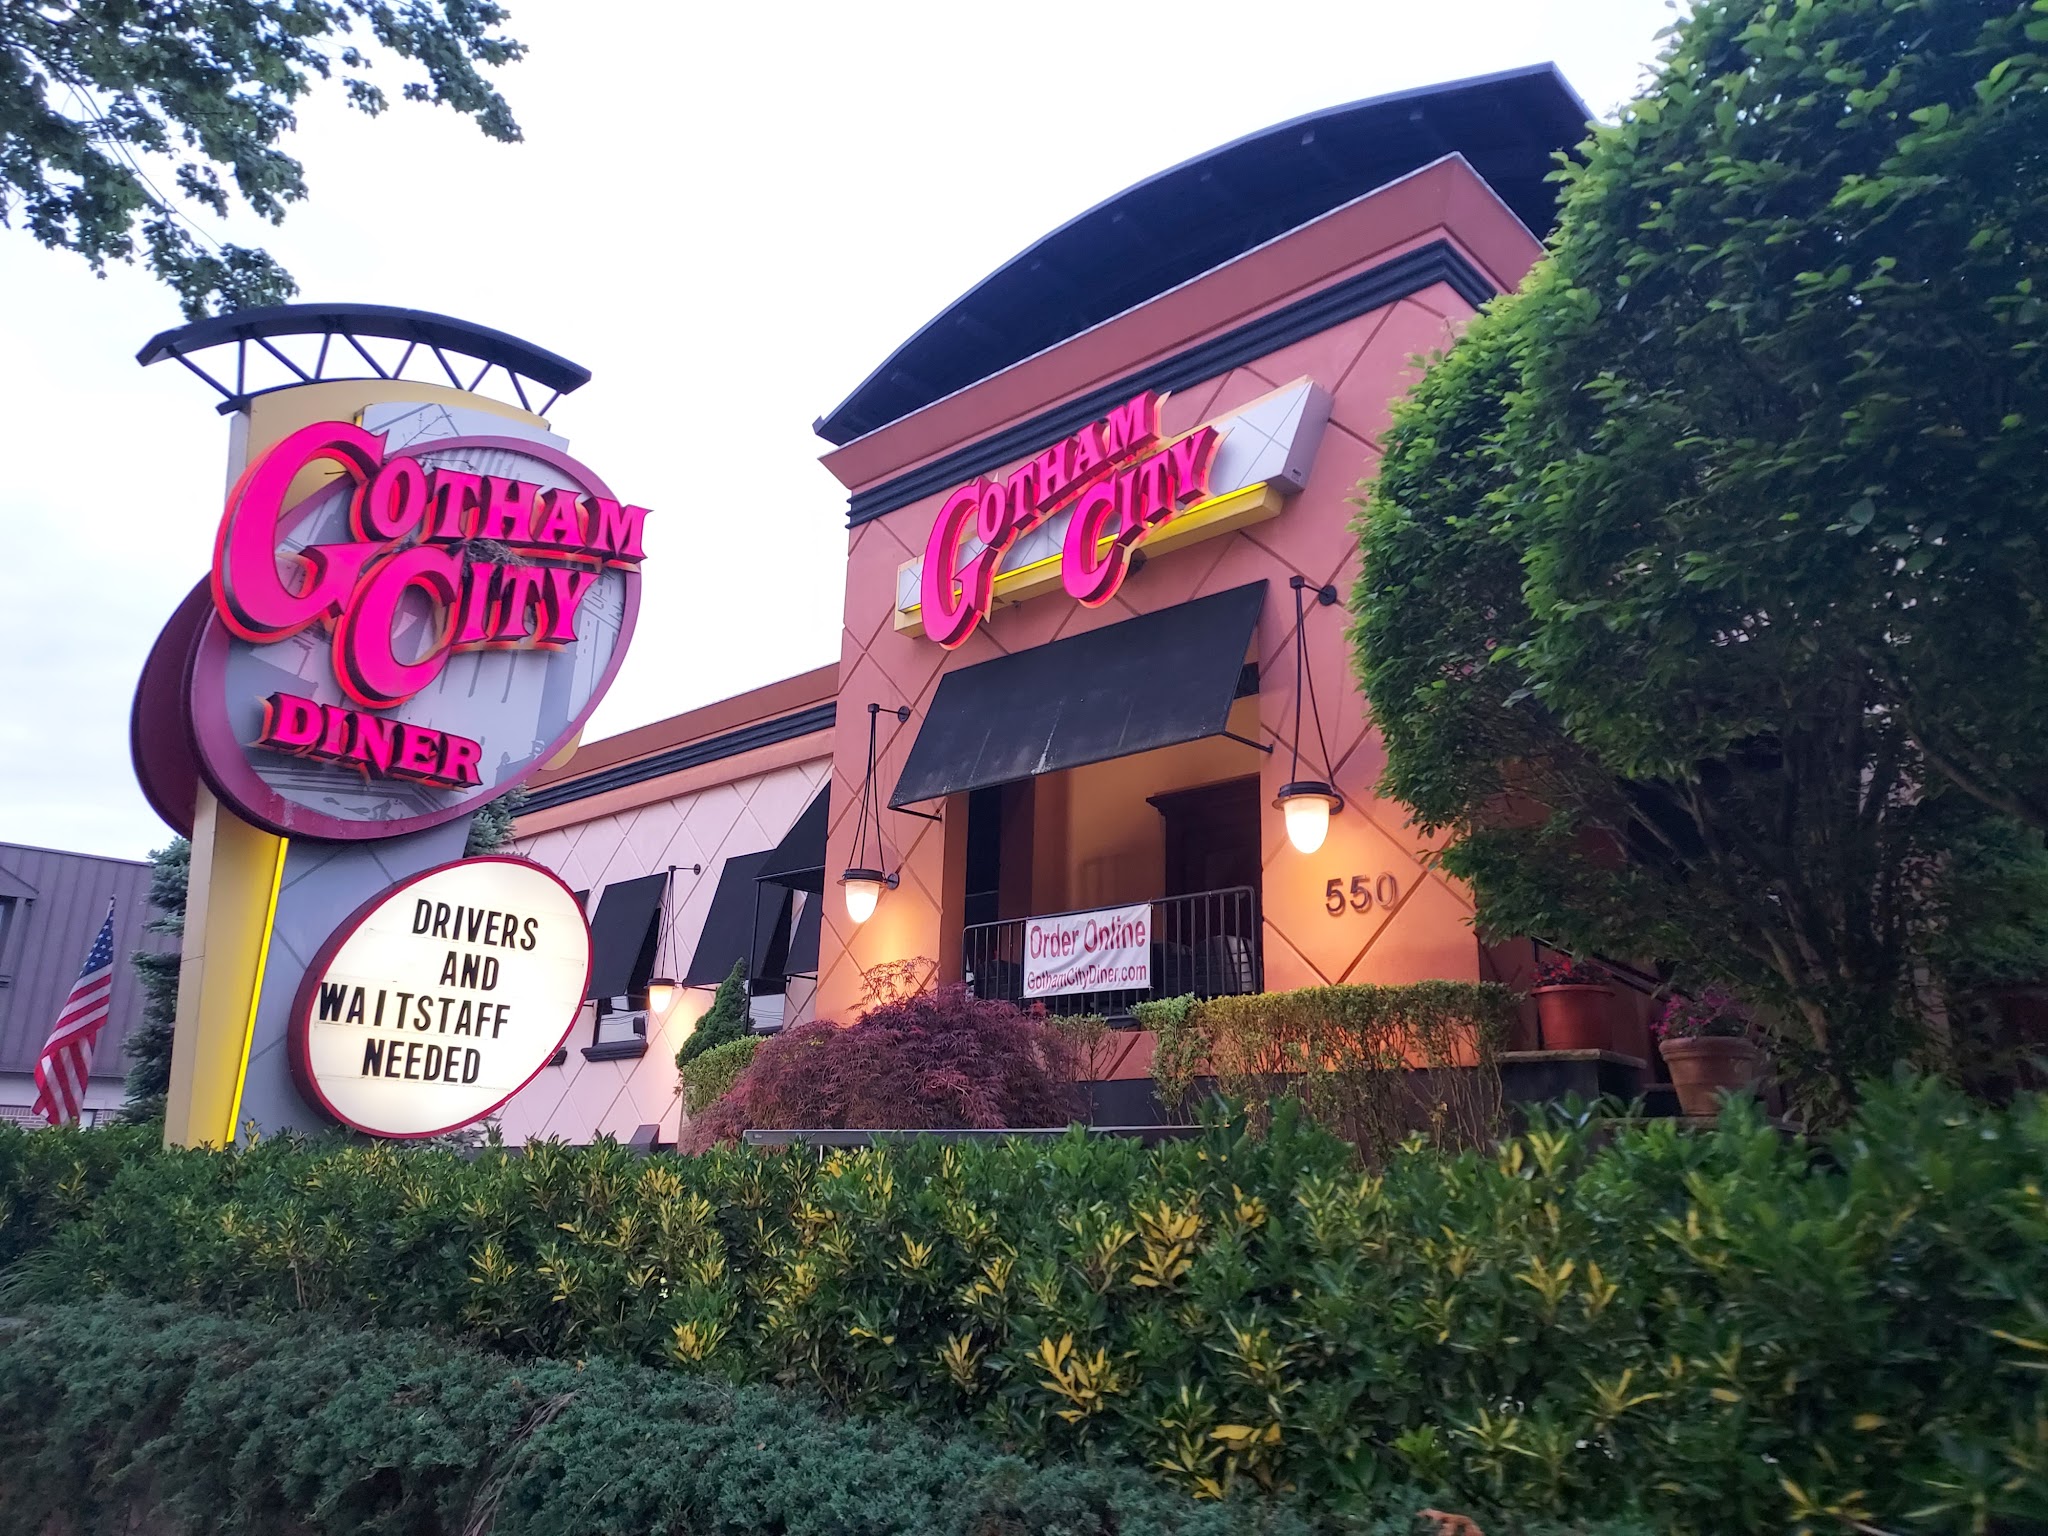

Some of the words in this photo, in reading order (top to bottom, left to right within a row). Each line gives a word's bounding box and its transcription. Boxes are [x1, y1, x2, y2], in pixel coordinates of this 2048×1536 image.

[213, 420, 654, 641] GOTHAM
[920, 389, 1168, 648] GOTHAM
[1061, 425, 1224, 606] CITY
[333, 544, 600, 708] CITY
[264, 691, 483, 790] DINER
[1325, 871, 1398, 917] 550
[412, 898, 539, 951] DRIVERS
[1029, 923, 1079, 960] Order
[1083, 915, 1146, 953] Online
[439, 951, 500, 991] AND
[1027, 964, 1147, 990] GothamCityDiner.com
[319, 981, 511, 1039] WAITSTAFF
[361, 1038, 481, 1084] NEEDED
